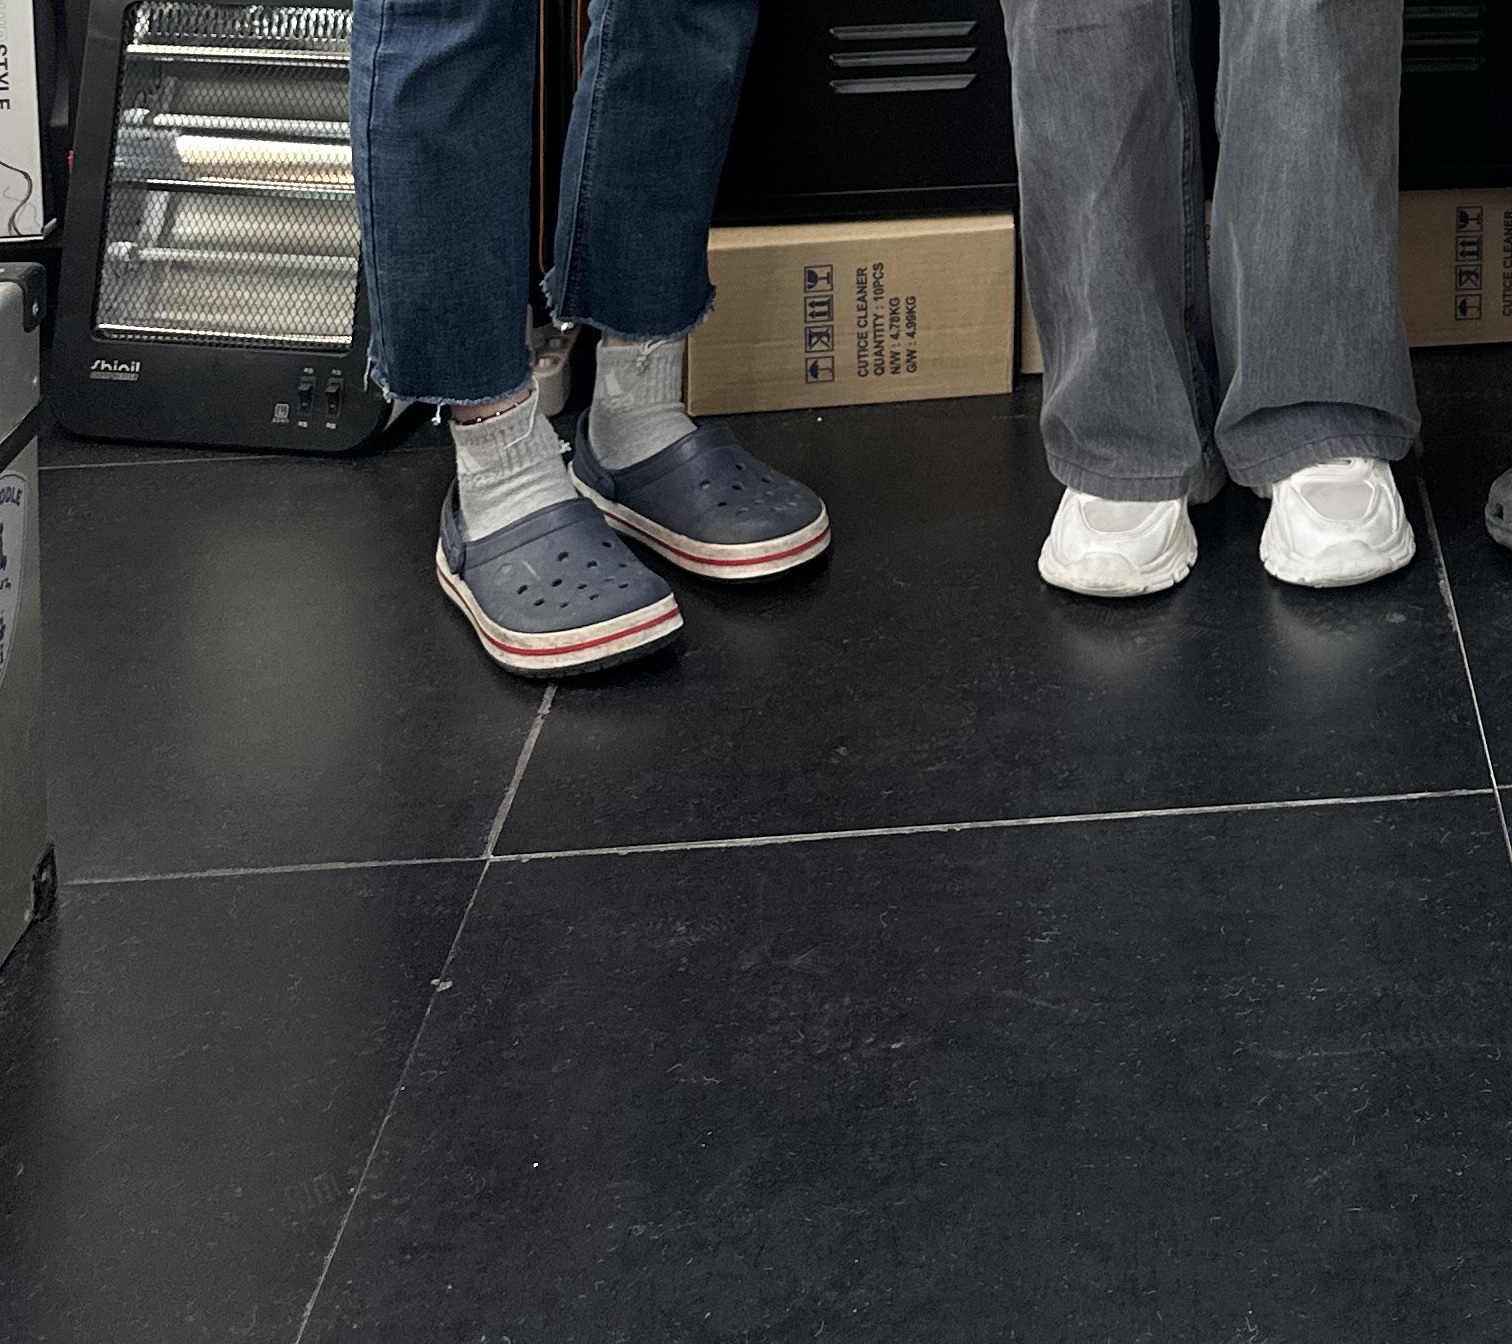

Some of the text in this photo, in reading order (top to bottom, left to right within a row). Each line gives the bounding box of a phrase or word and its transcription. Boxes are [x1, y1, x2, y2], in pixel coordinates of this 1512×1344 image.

[873, 262, 885, 303] 10PCS
[856, 267, 869, 377] CUTICE CLEANER
[873, 313, 886, 377] QUANTITY
[905, 349, 918, 374] G/W
[90, 359, 141, 373] Shinil
[890, 350, 901, 375] N/W
